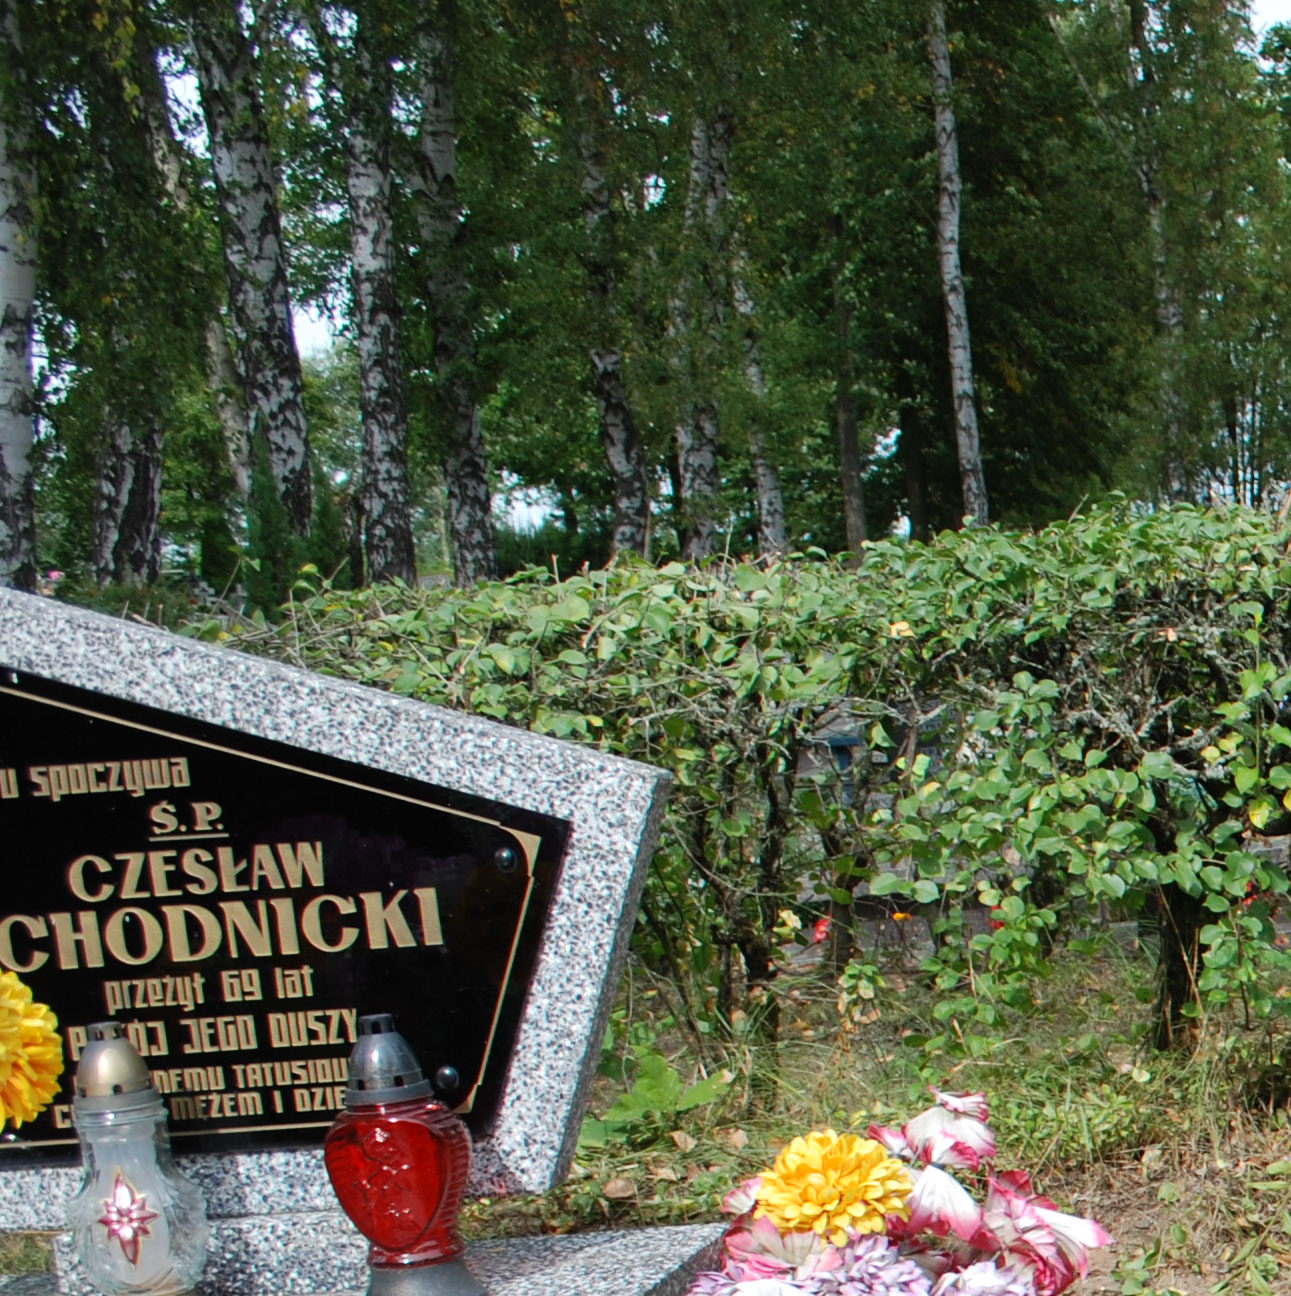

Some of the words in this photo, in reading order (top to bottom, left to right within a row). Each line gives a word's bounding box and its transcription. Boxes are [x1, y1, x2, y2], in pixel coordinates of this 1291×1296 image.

[29, 757, 191, 802] spoczywa
[67, 842, 325, 902] CZESŁAW
[0, 887, 443, 973] CHODNICKI
[104, 972, 205, 1015] przeżył
[221, 968, 263, 1002] 69
[274, 965, 314, 999] lat
[67, 1018, 169, 1060] PÓJ
[180, 1014, 258, 1054] JEGO
[267, 1008, 358, 1048] DUSZY
[273, 1090, 284, 1113] I
